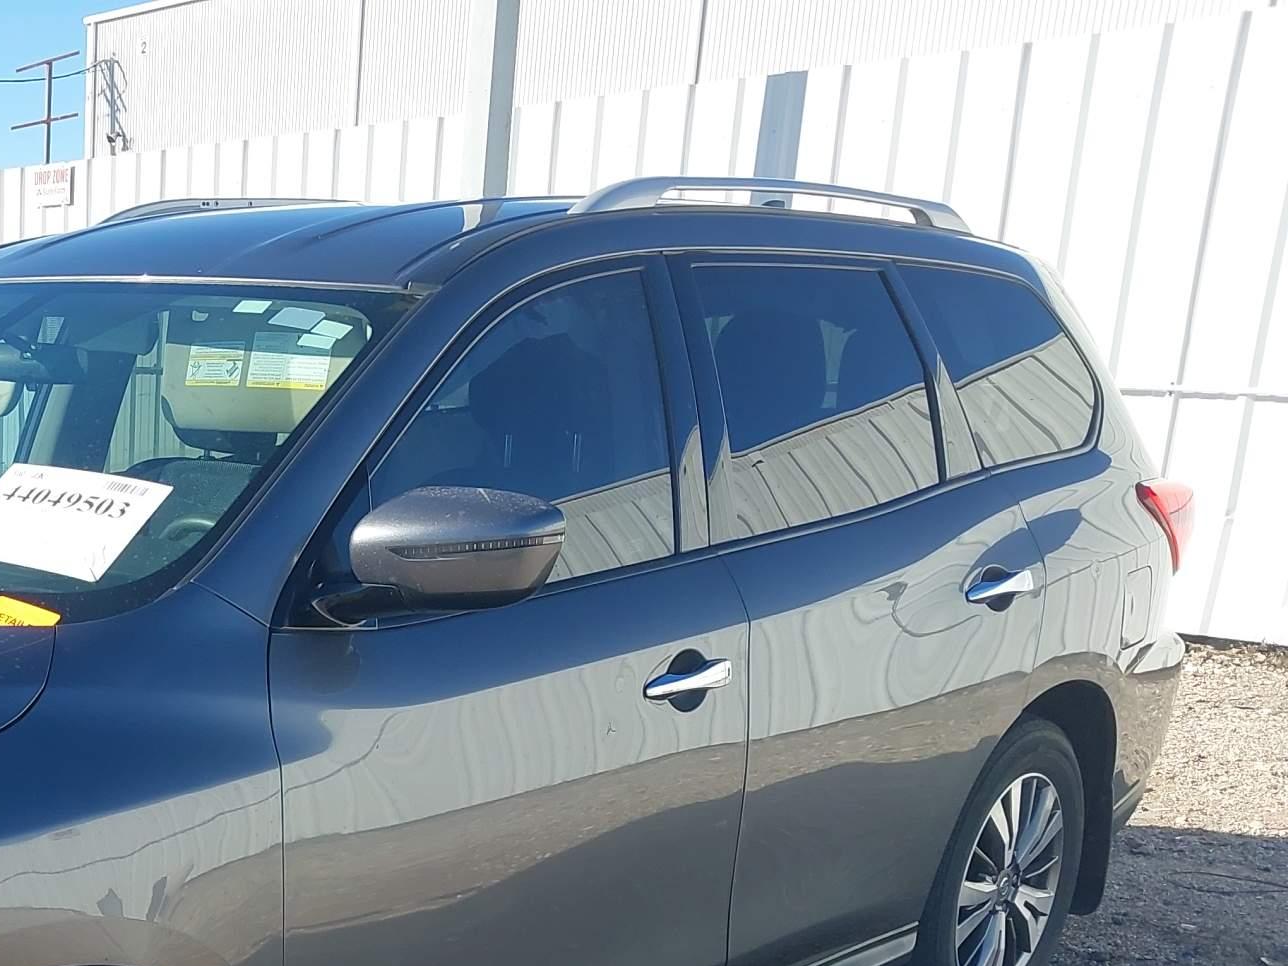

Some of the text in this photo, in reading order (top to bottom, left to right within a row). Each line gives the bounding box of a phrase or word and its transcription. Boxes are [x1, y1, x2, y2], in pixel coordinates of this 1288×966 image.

[34, 168, 69, 185] DROP ZONE
[2, 485, 131, 519] 44049503
